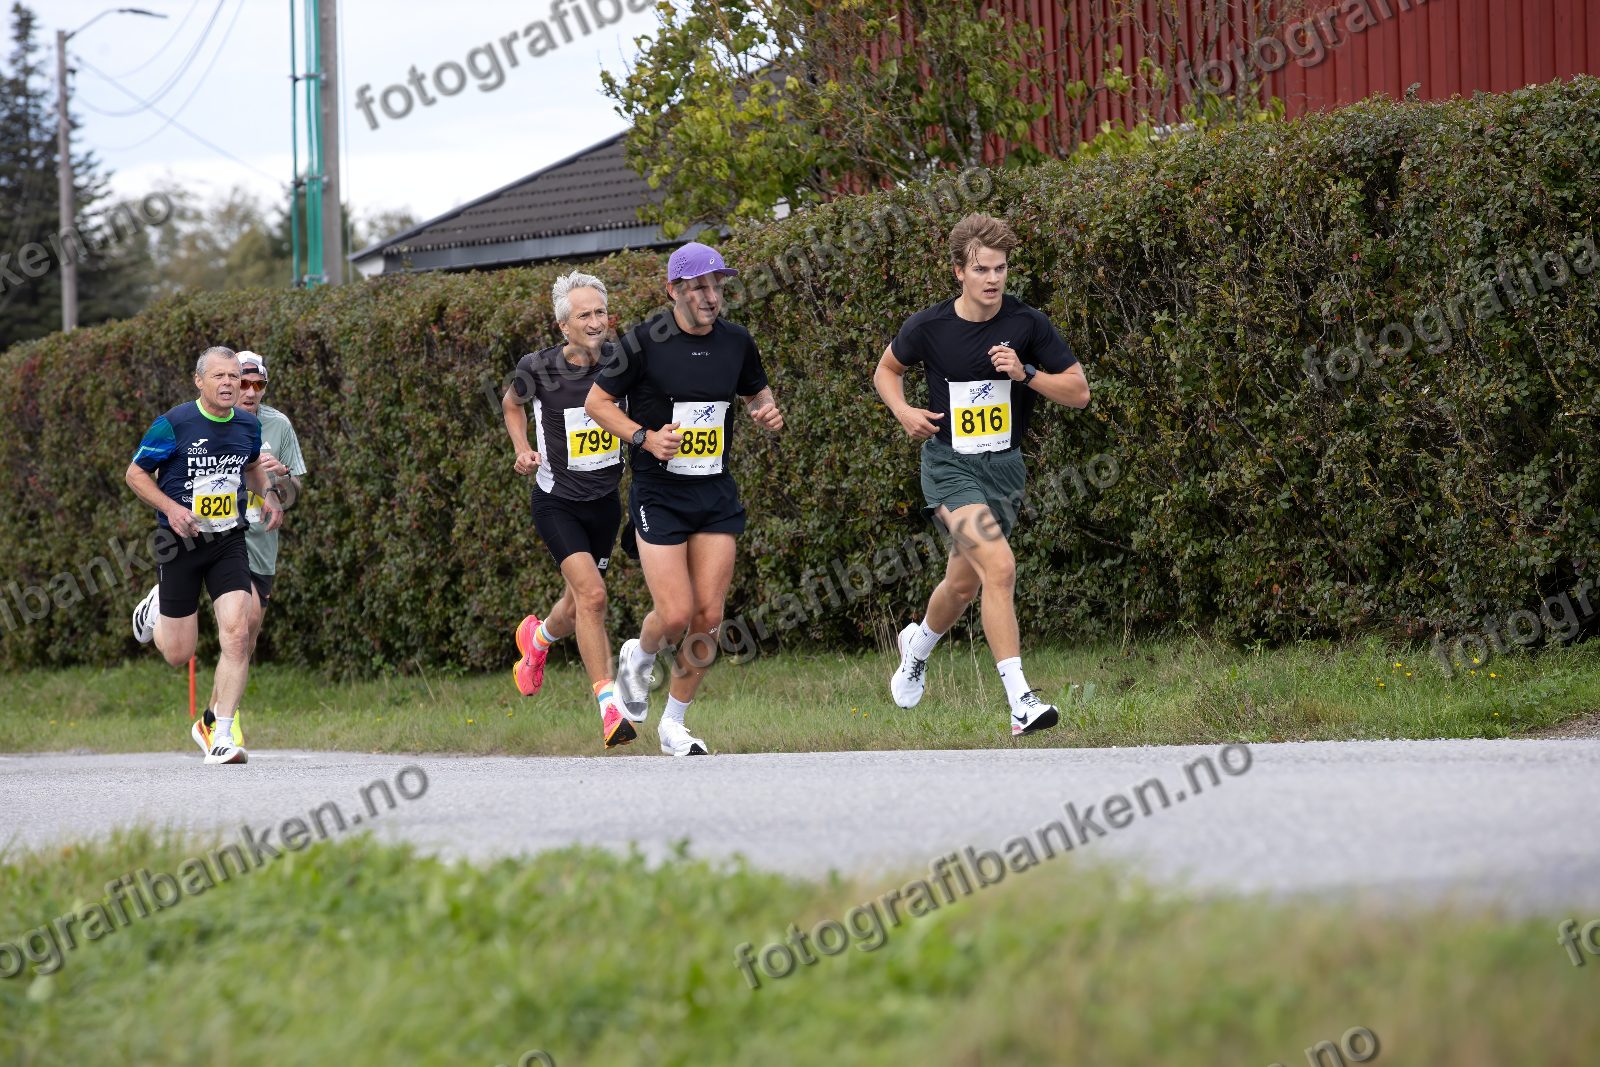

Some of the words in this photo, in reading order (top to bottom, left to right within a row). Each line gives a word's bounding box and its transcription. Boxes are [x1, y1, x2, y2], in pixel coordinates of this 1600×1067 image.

[961, 406, 1003, 434] 816
[575, 429, 613, 454] 799
[680, 429, 718, 455] 859
[187, 456, 217, 467] run
[200, 495, 232, 516] 820
